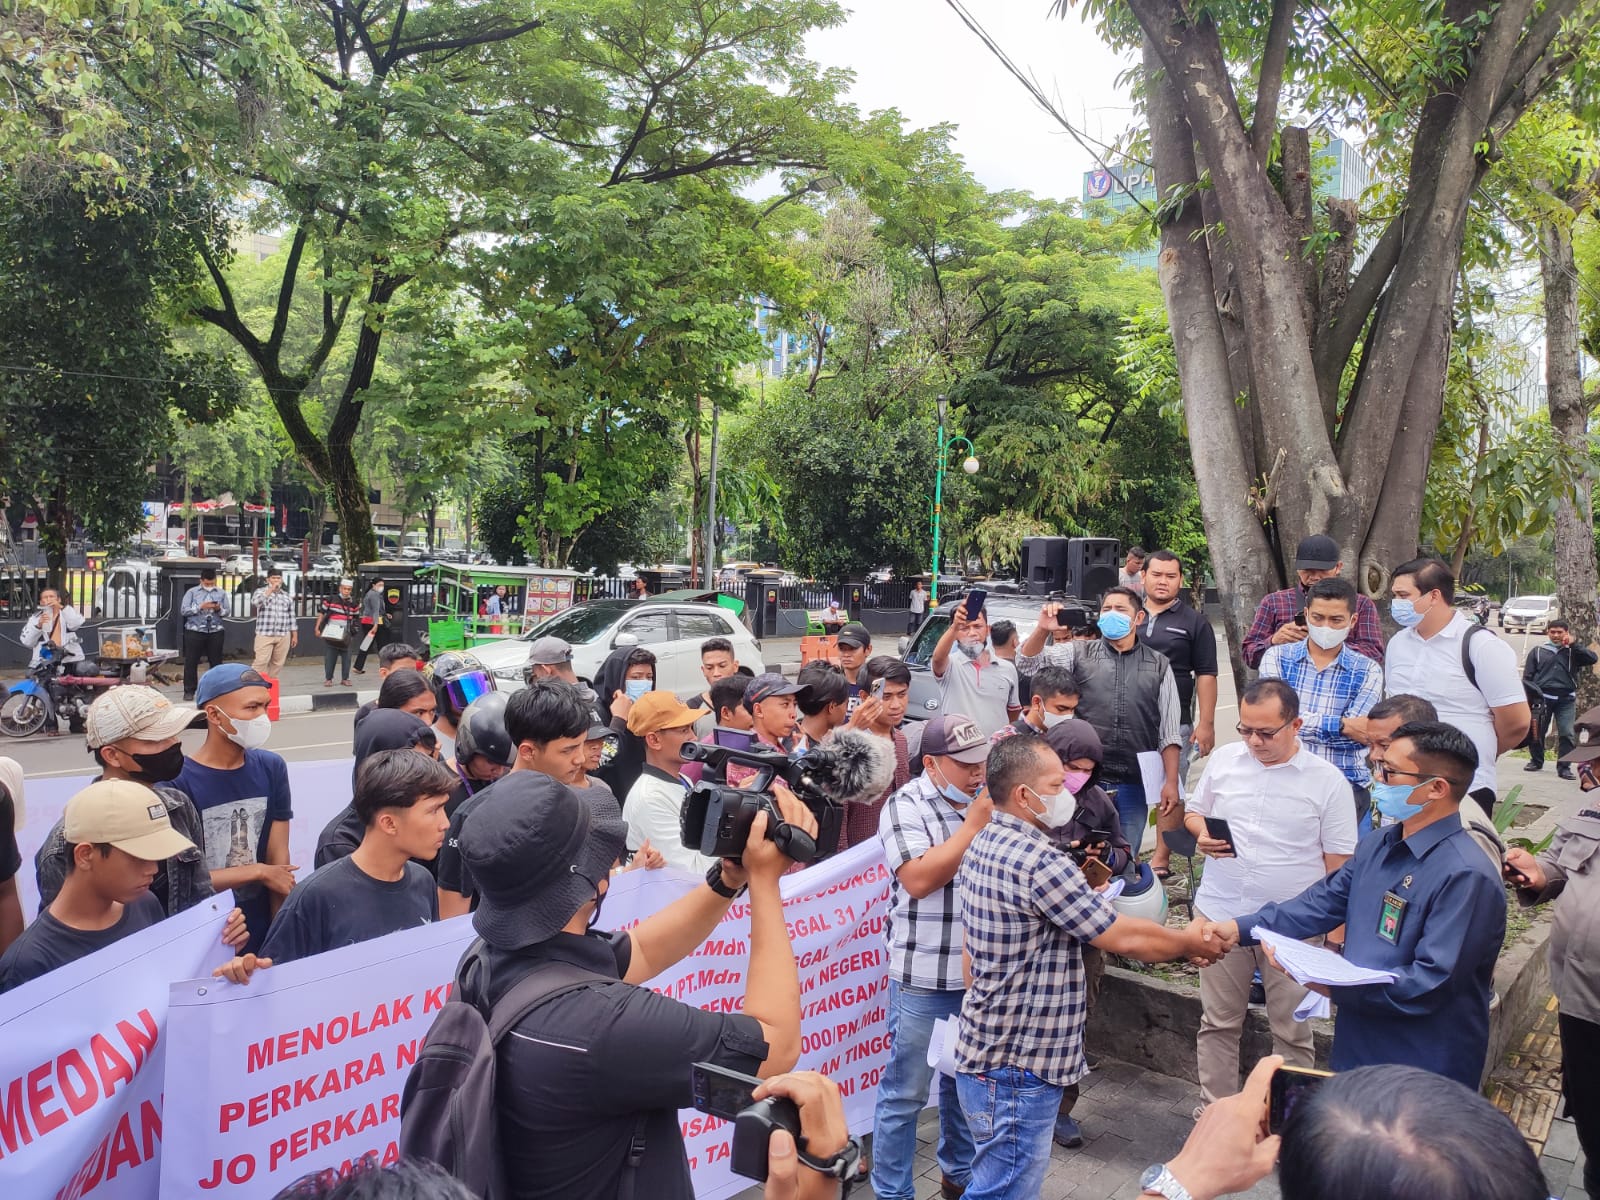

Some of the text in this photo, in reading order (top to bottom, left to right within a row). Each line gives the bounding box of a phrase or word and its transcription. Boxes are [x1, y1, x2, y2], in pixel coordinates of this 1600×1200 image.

[819, 948, 881, 986] NEGERI
[219, 1052, 386, 1134] PERKARA
[396, 1035, 428, 1070] N
[834, 905, 855, 926] 31
[247, 994, 414, 1074] MENOLAK
[0, 1008, 159, 1161] MEDAN
[860, 1065, 887, 1091] 20
[199, 1153, 256, 1190] JO
